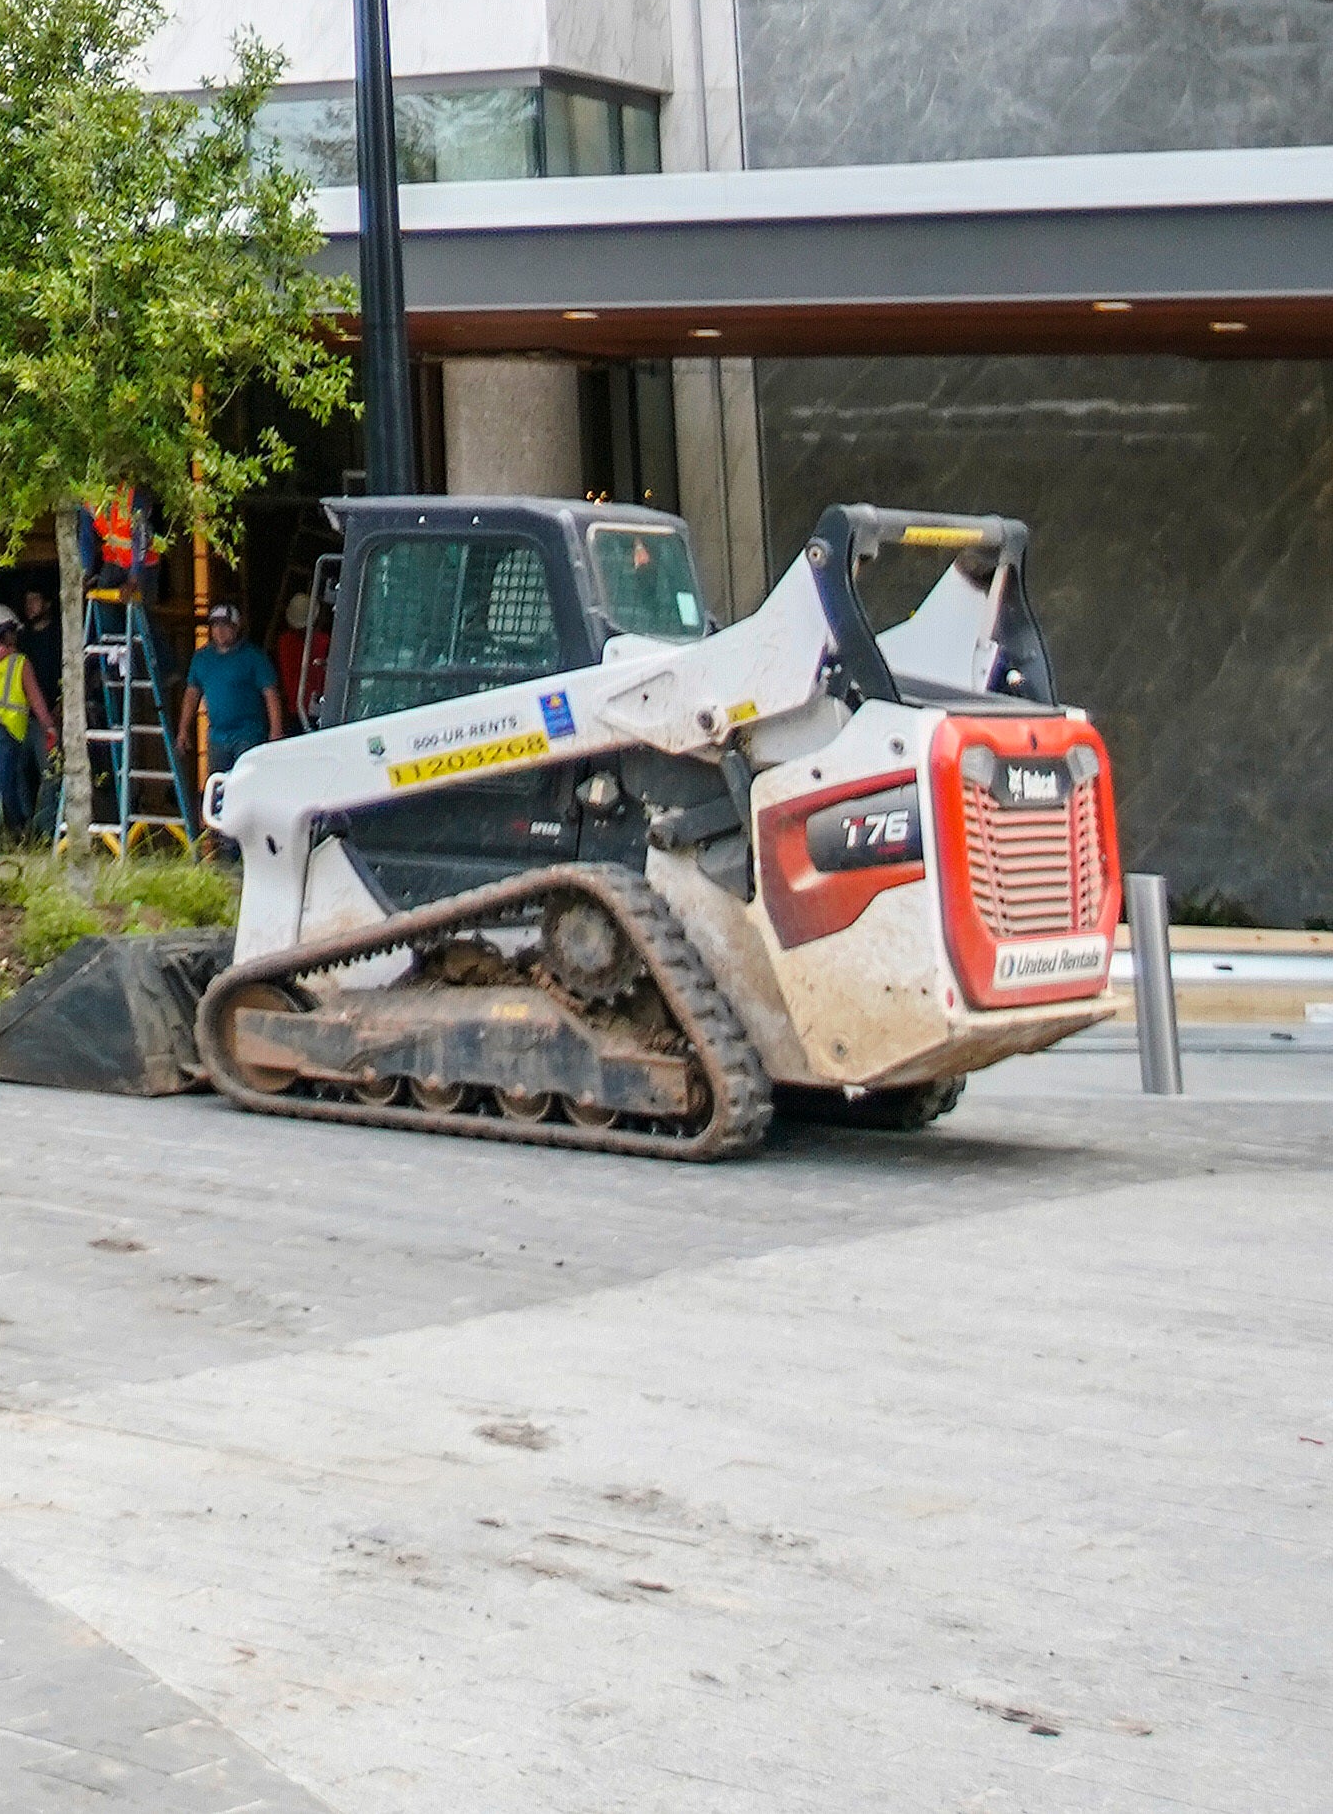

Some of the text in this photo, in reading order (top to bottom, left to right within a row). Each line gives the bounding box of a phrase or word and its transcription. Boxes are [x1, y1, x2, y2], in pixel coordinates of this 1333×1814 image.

[841, 810, 910, 849] T76
[1016, 947, 1102, 976] United Rentals
